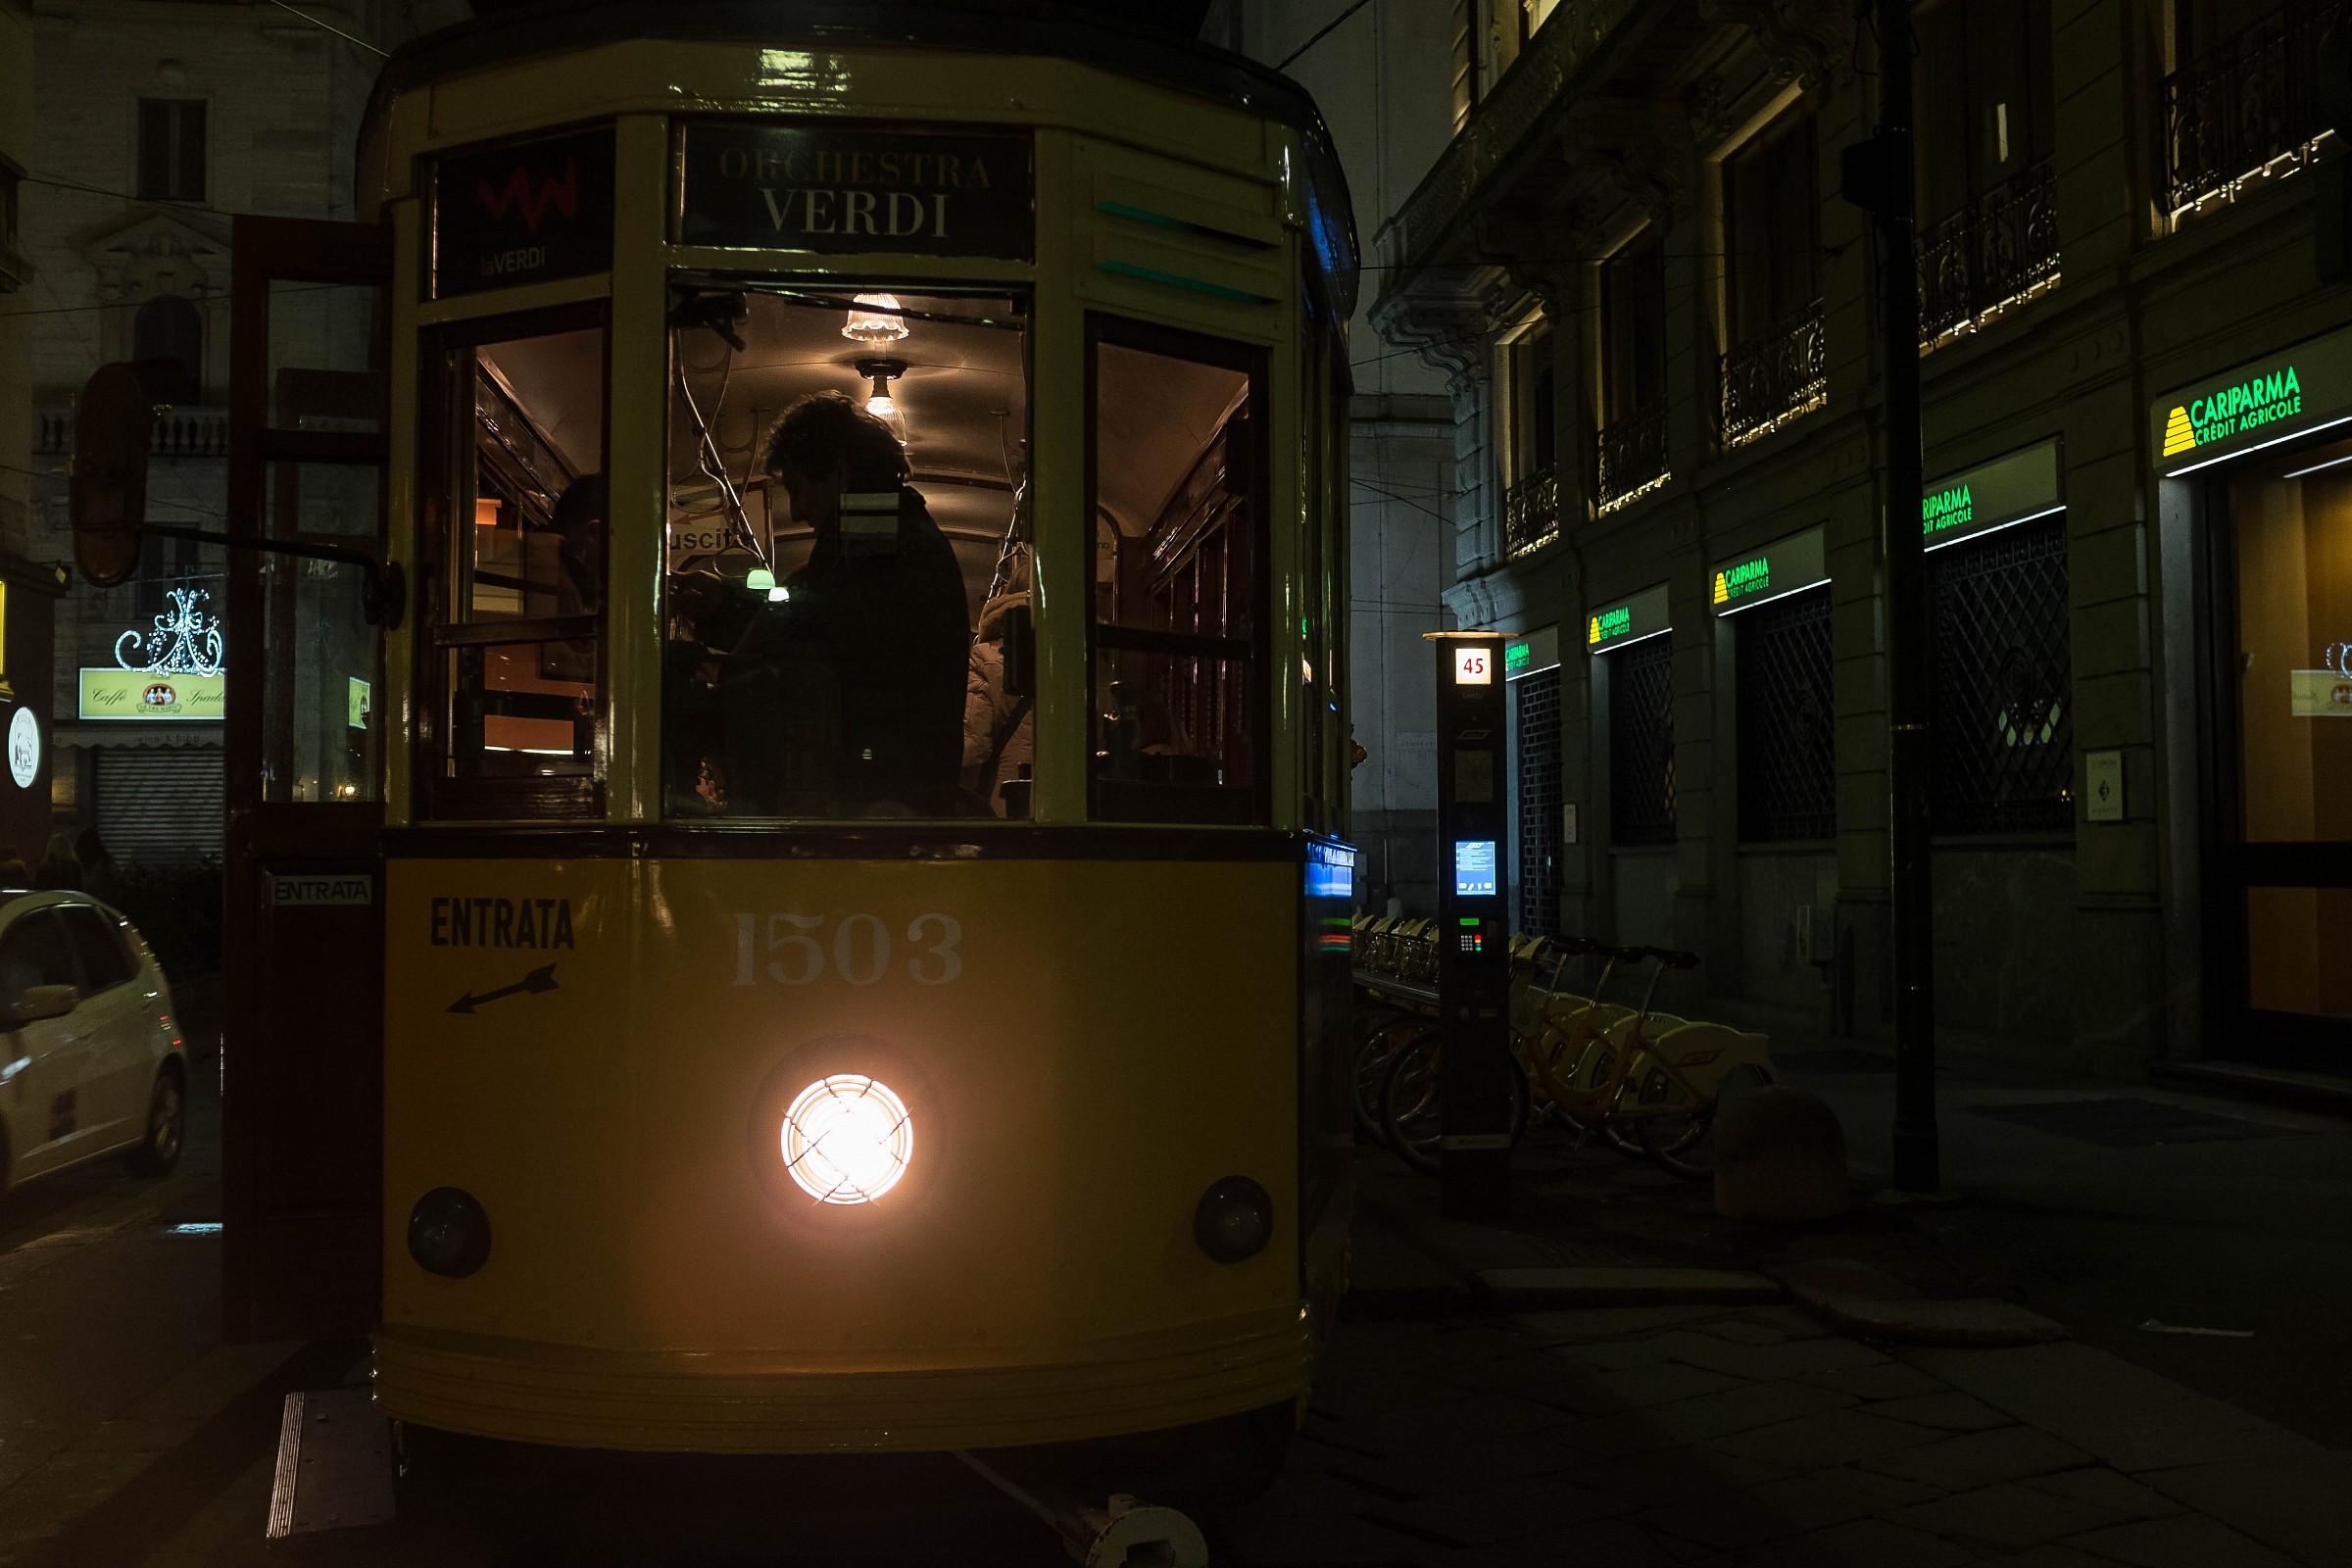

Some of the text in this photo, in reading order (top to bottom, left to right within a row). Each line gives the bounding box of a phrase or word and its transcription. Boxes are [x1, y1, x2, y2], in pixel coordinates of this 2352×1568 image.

[718, 147, 991, 189] ORCHESTRA
[760, 187, 952, 238] VERDI
[480, 246, 547, 276] laVERDI
[2190, 366, 2301, 428] CARIPARMA
[2239, 396, 2302, 431] AGRICOLE
[1923, 483, 1972, 520] RIPARMA
[1936, 507, 1972, 530] AGRICOLE
[670, 528, 755, 550] uscit
[1725, 556, 1769, 589] CARIPARMA
[1463, 658, 1484, 674] 45
[274, 880, 368, 901] ENTRATA
[429, 896, 575, 951] ENTRATA
[731, 912, 963, 987] 1503
